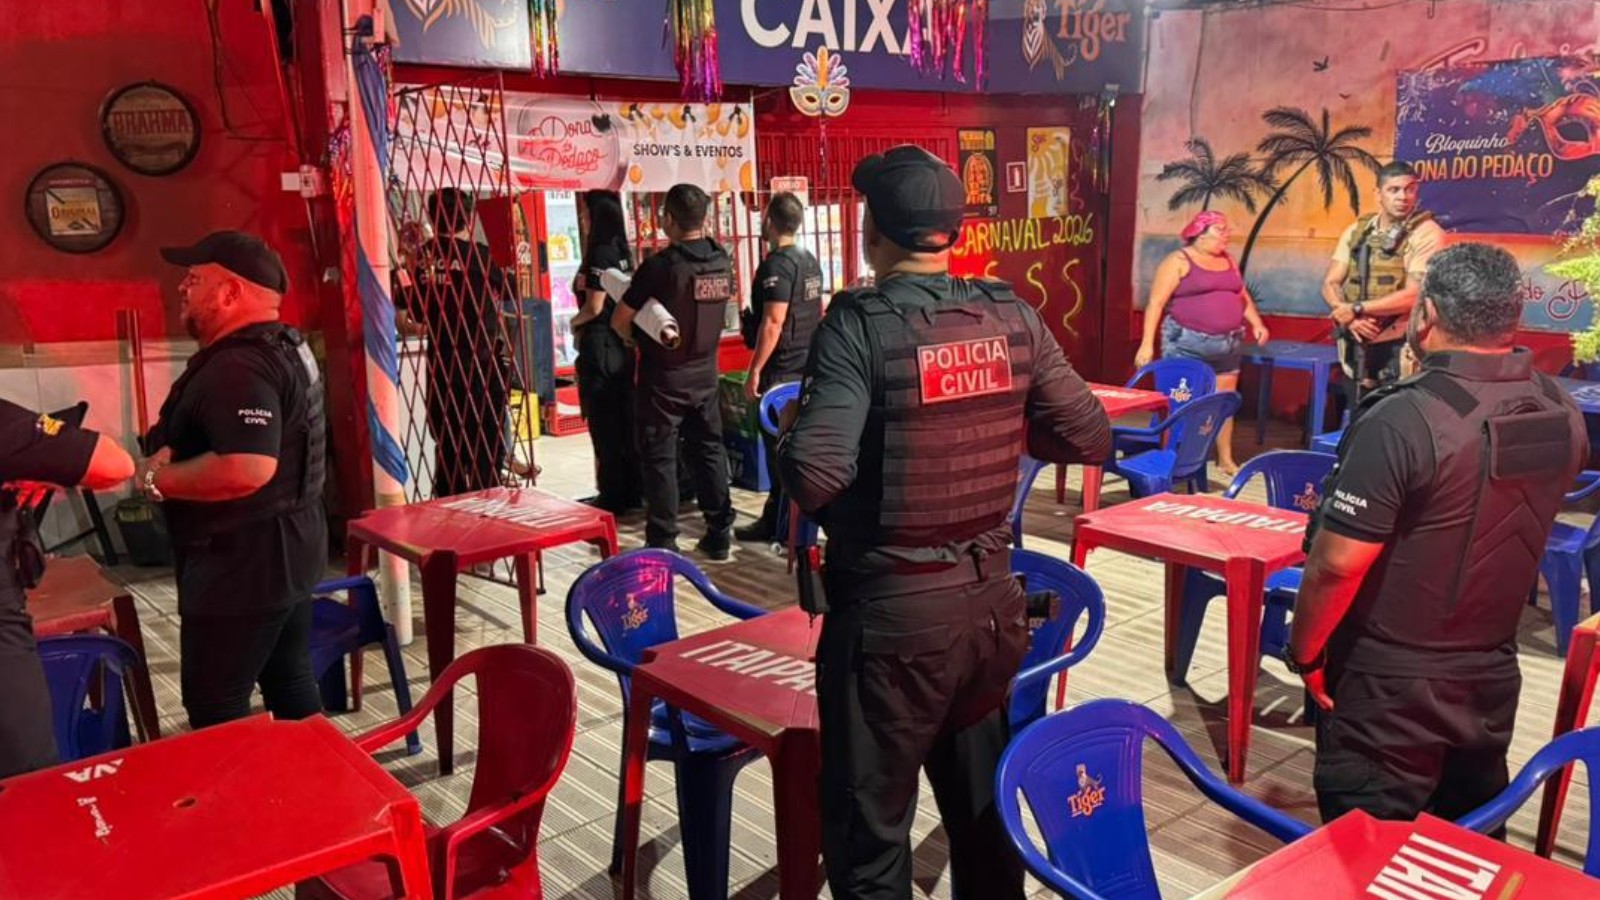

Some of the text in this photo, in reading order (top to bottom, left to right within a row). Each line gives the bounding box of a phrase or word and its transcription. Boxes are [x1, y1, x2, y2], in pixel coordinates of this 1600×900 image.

[1056, 0, 1131, 62] Tiger
[113, 111, 191, 134] BRAHMA
[633, 144, 743, 158] SHOW'S & EVENTOS
[1425, 133, 1508, 156] Bloquinho
[1407, 153, 1553, 185] ONA DO PEDAÇO
[1053, 213, 1093, 246] 2026
[940, 367, 999, 396] CIVIL
[679, 640, 817, 696] ITAIPA
[1067, 786, 1106, 818] Tiger
